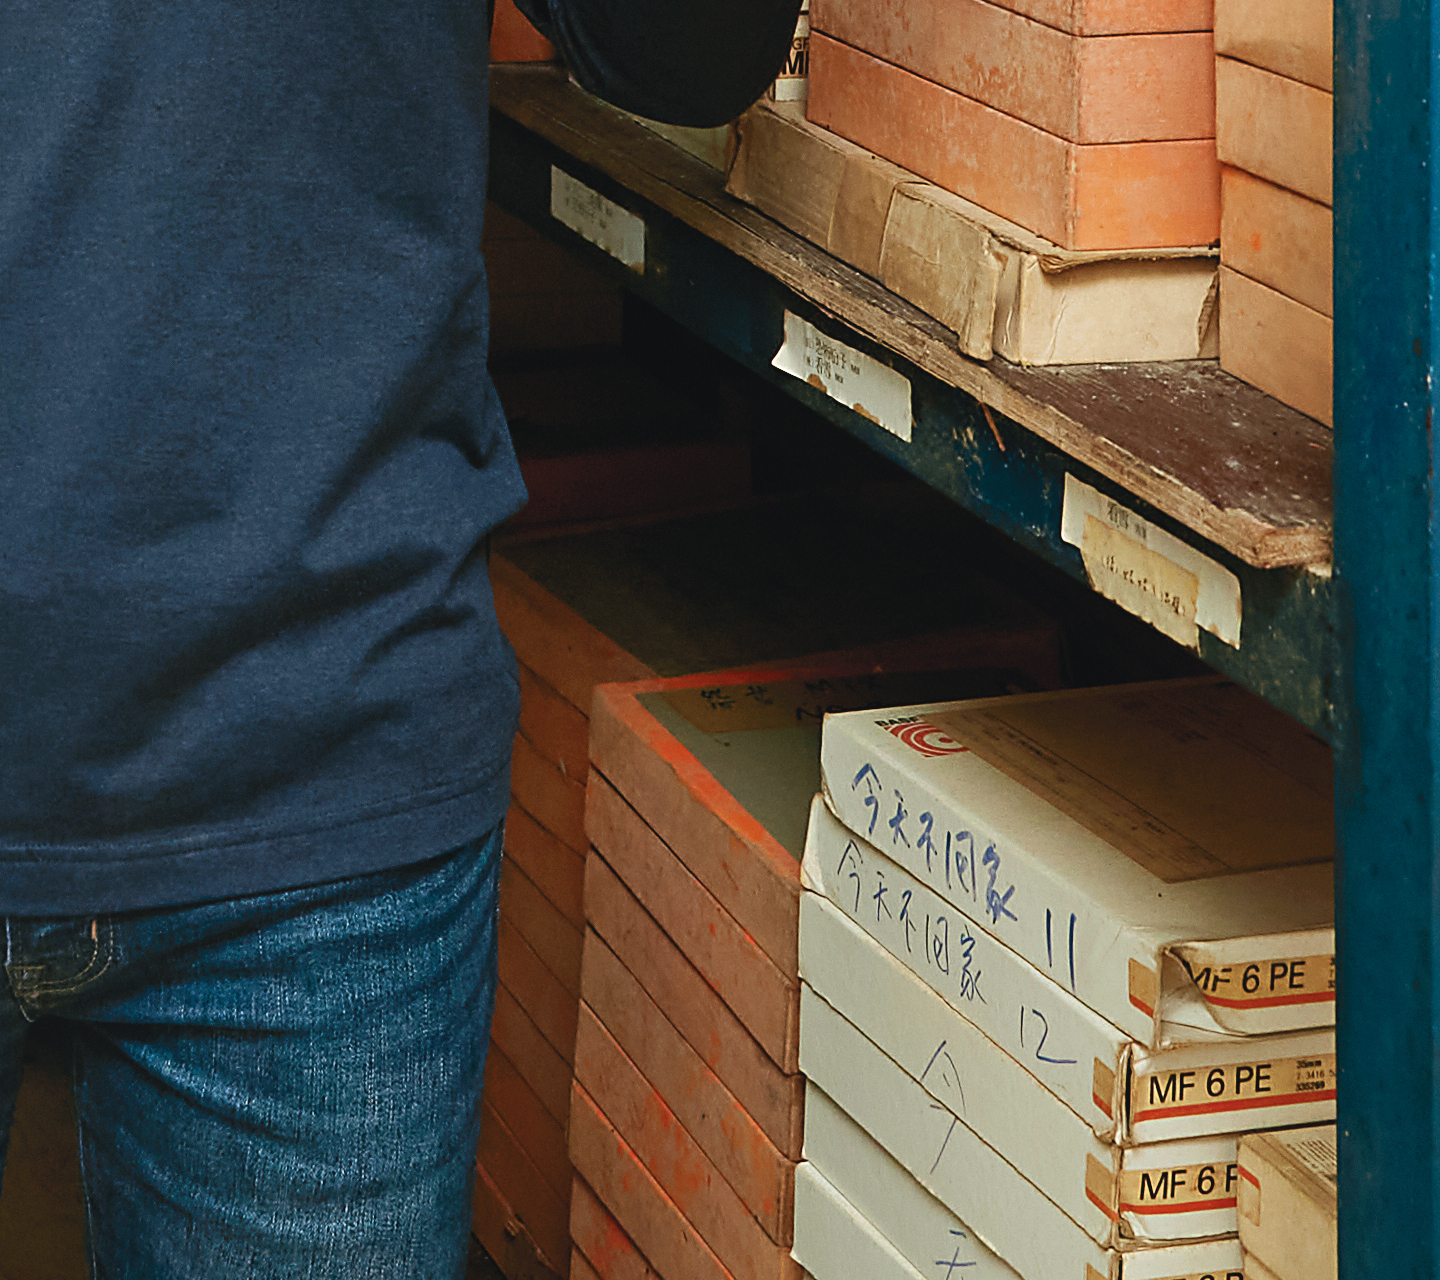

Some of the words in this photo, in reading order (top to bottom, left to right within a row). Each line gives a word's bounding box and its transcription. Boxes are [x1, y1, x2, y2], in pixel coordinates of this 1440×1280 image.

[1242, 965, 1260, 993] 6
[1270, 961, 1306, 990] PE
[1020, 1006, 1077, 1064] 12
[1149, 1072, 1196, 1104] MF
[1206, 1068, 1225, 1097] 6
[1236, 1064, 1271, 1095] PE
[1139, 1170, 1187, 1201] MF
[1197, 1166, 1215, 1195] 6
